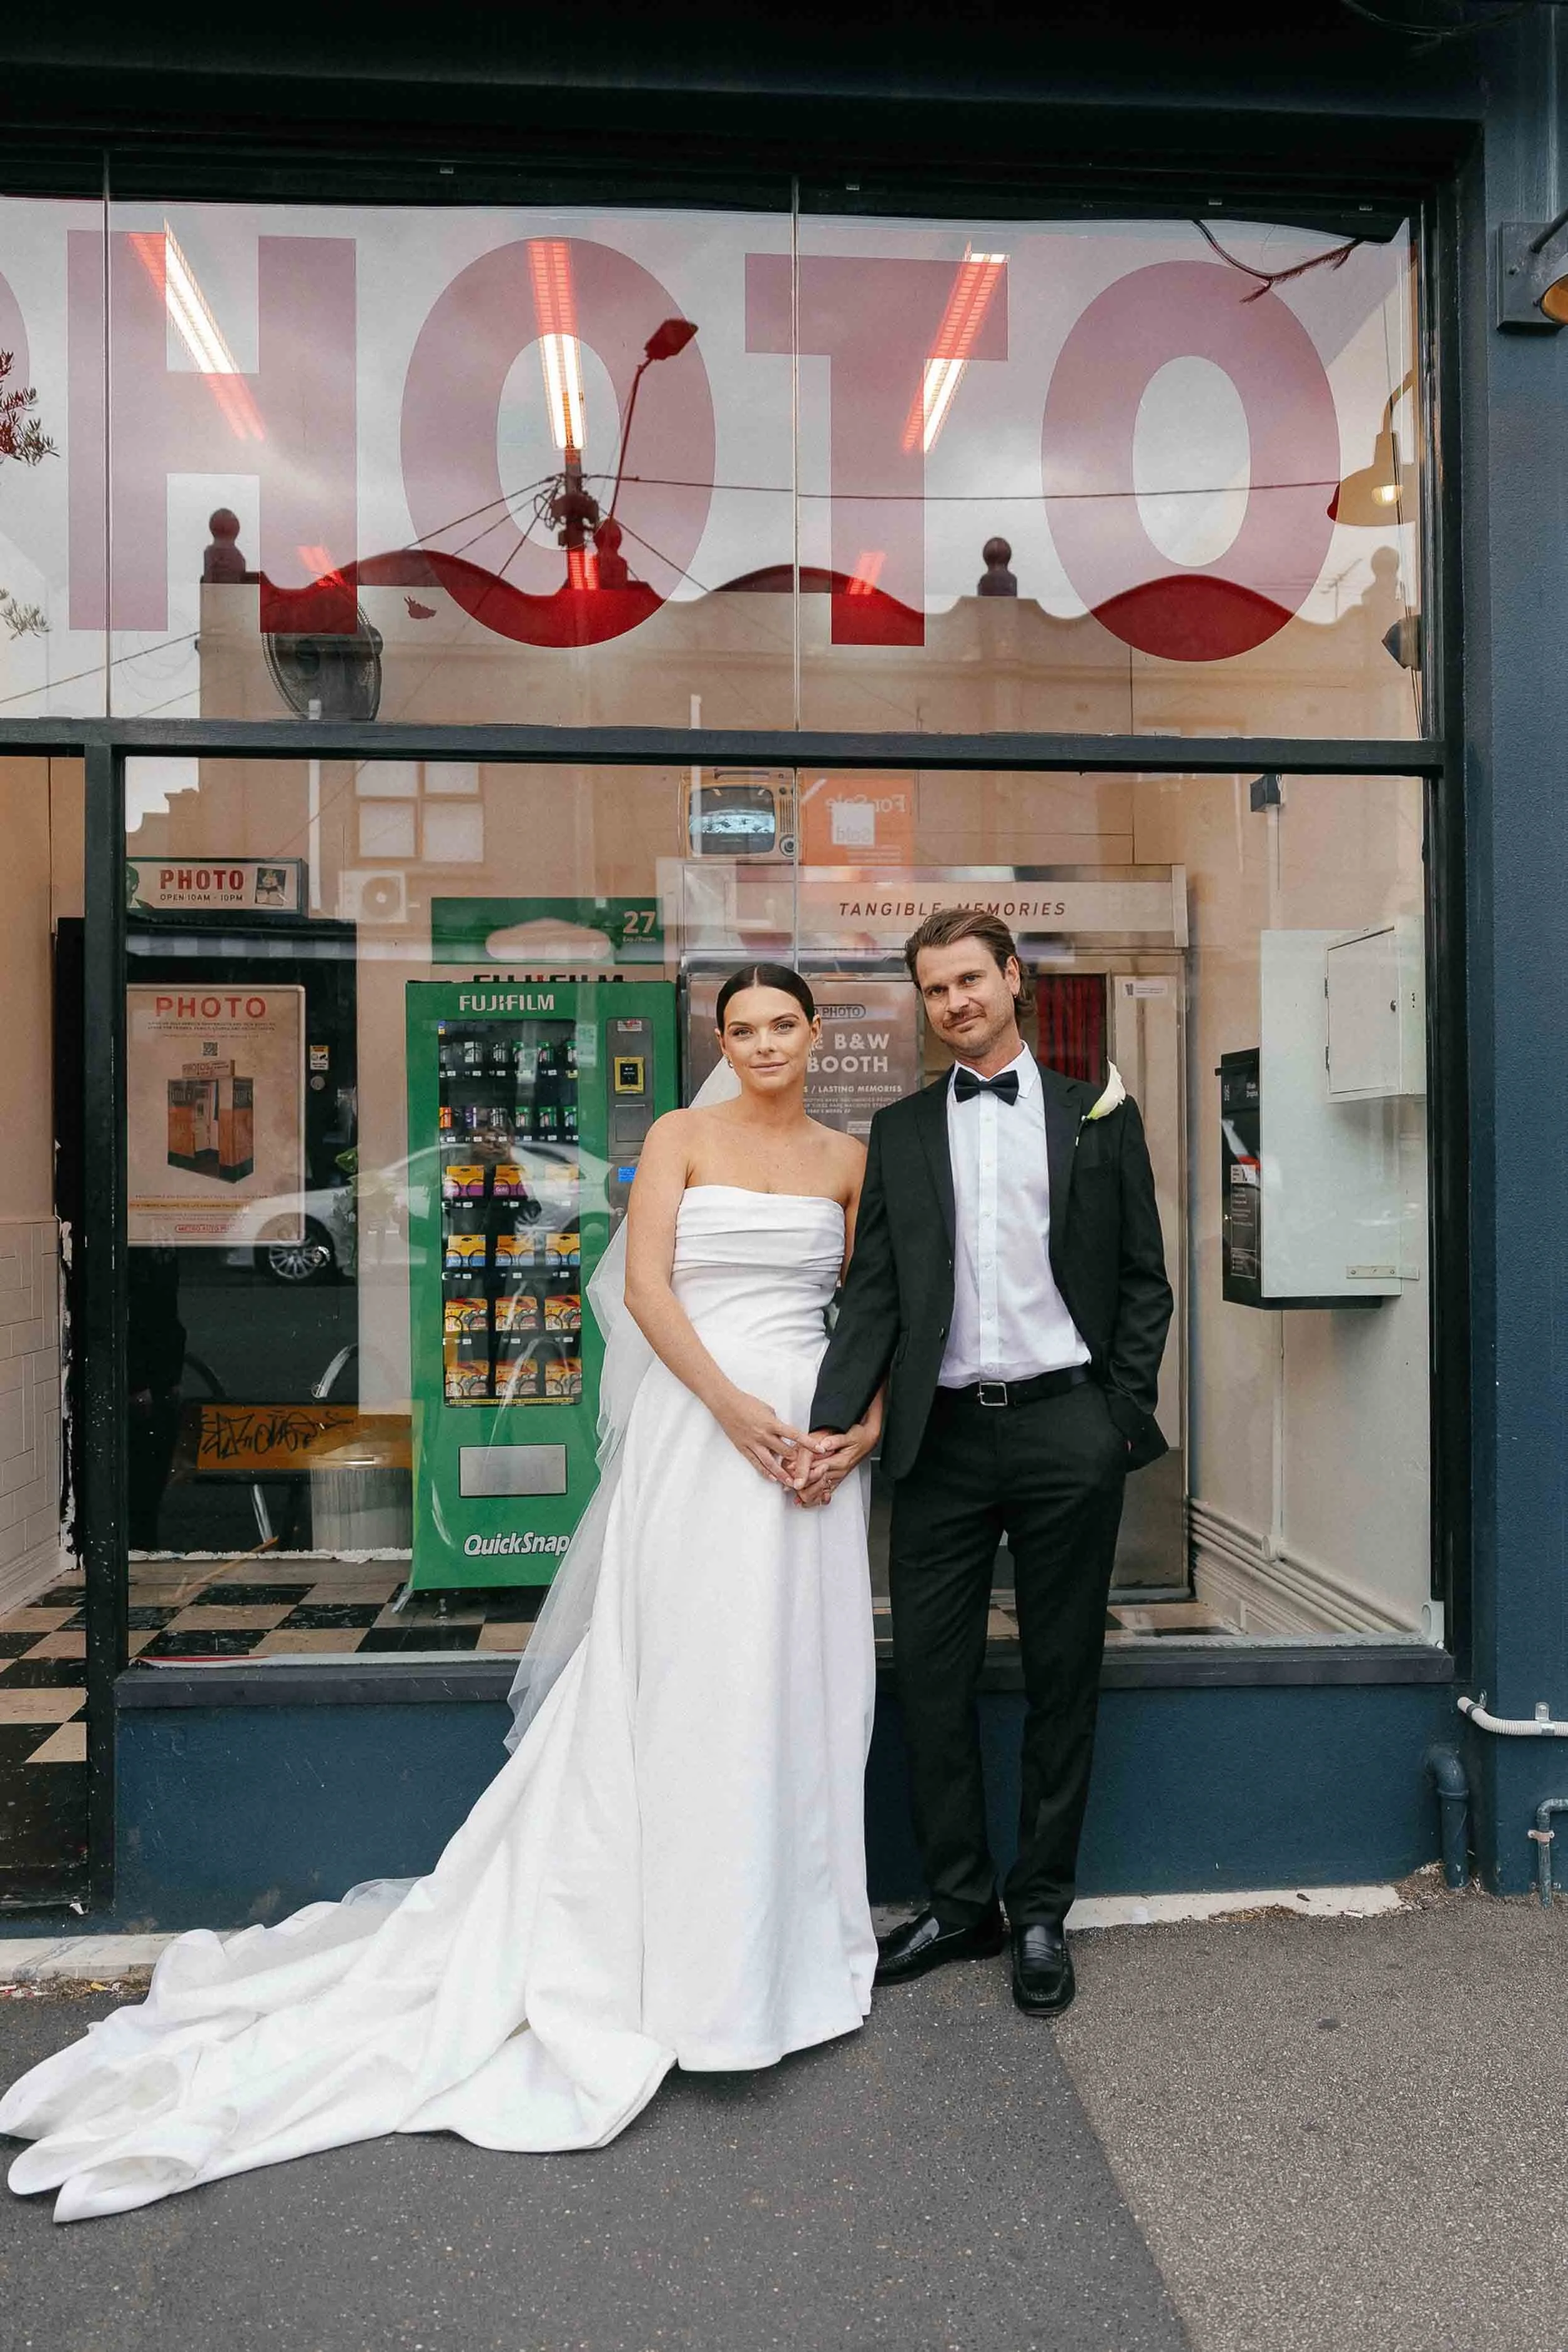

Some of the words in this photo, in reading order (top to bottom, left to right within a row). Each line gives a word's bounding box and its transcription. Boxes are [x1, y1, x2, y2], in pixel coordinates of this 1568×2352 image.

[0, 230, 1340, 661] HOTO
[160, 870, 244, 890] PHOTO
[839, 902, 941, 916] TANGIBLE
[623, 911, 655, 933] 27
[156, 997, 266, 1018] PHOTO
[459, 994, 554, 1011] FUJIFILM
[822, 1007, 861, 1016] PHOTO
[834, 1033, 890, 1050] B&W
[464, 1532, 570, 1556] QuickSnap
